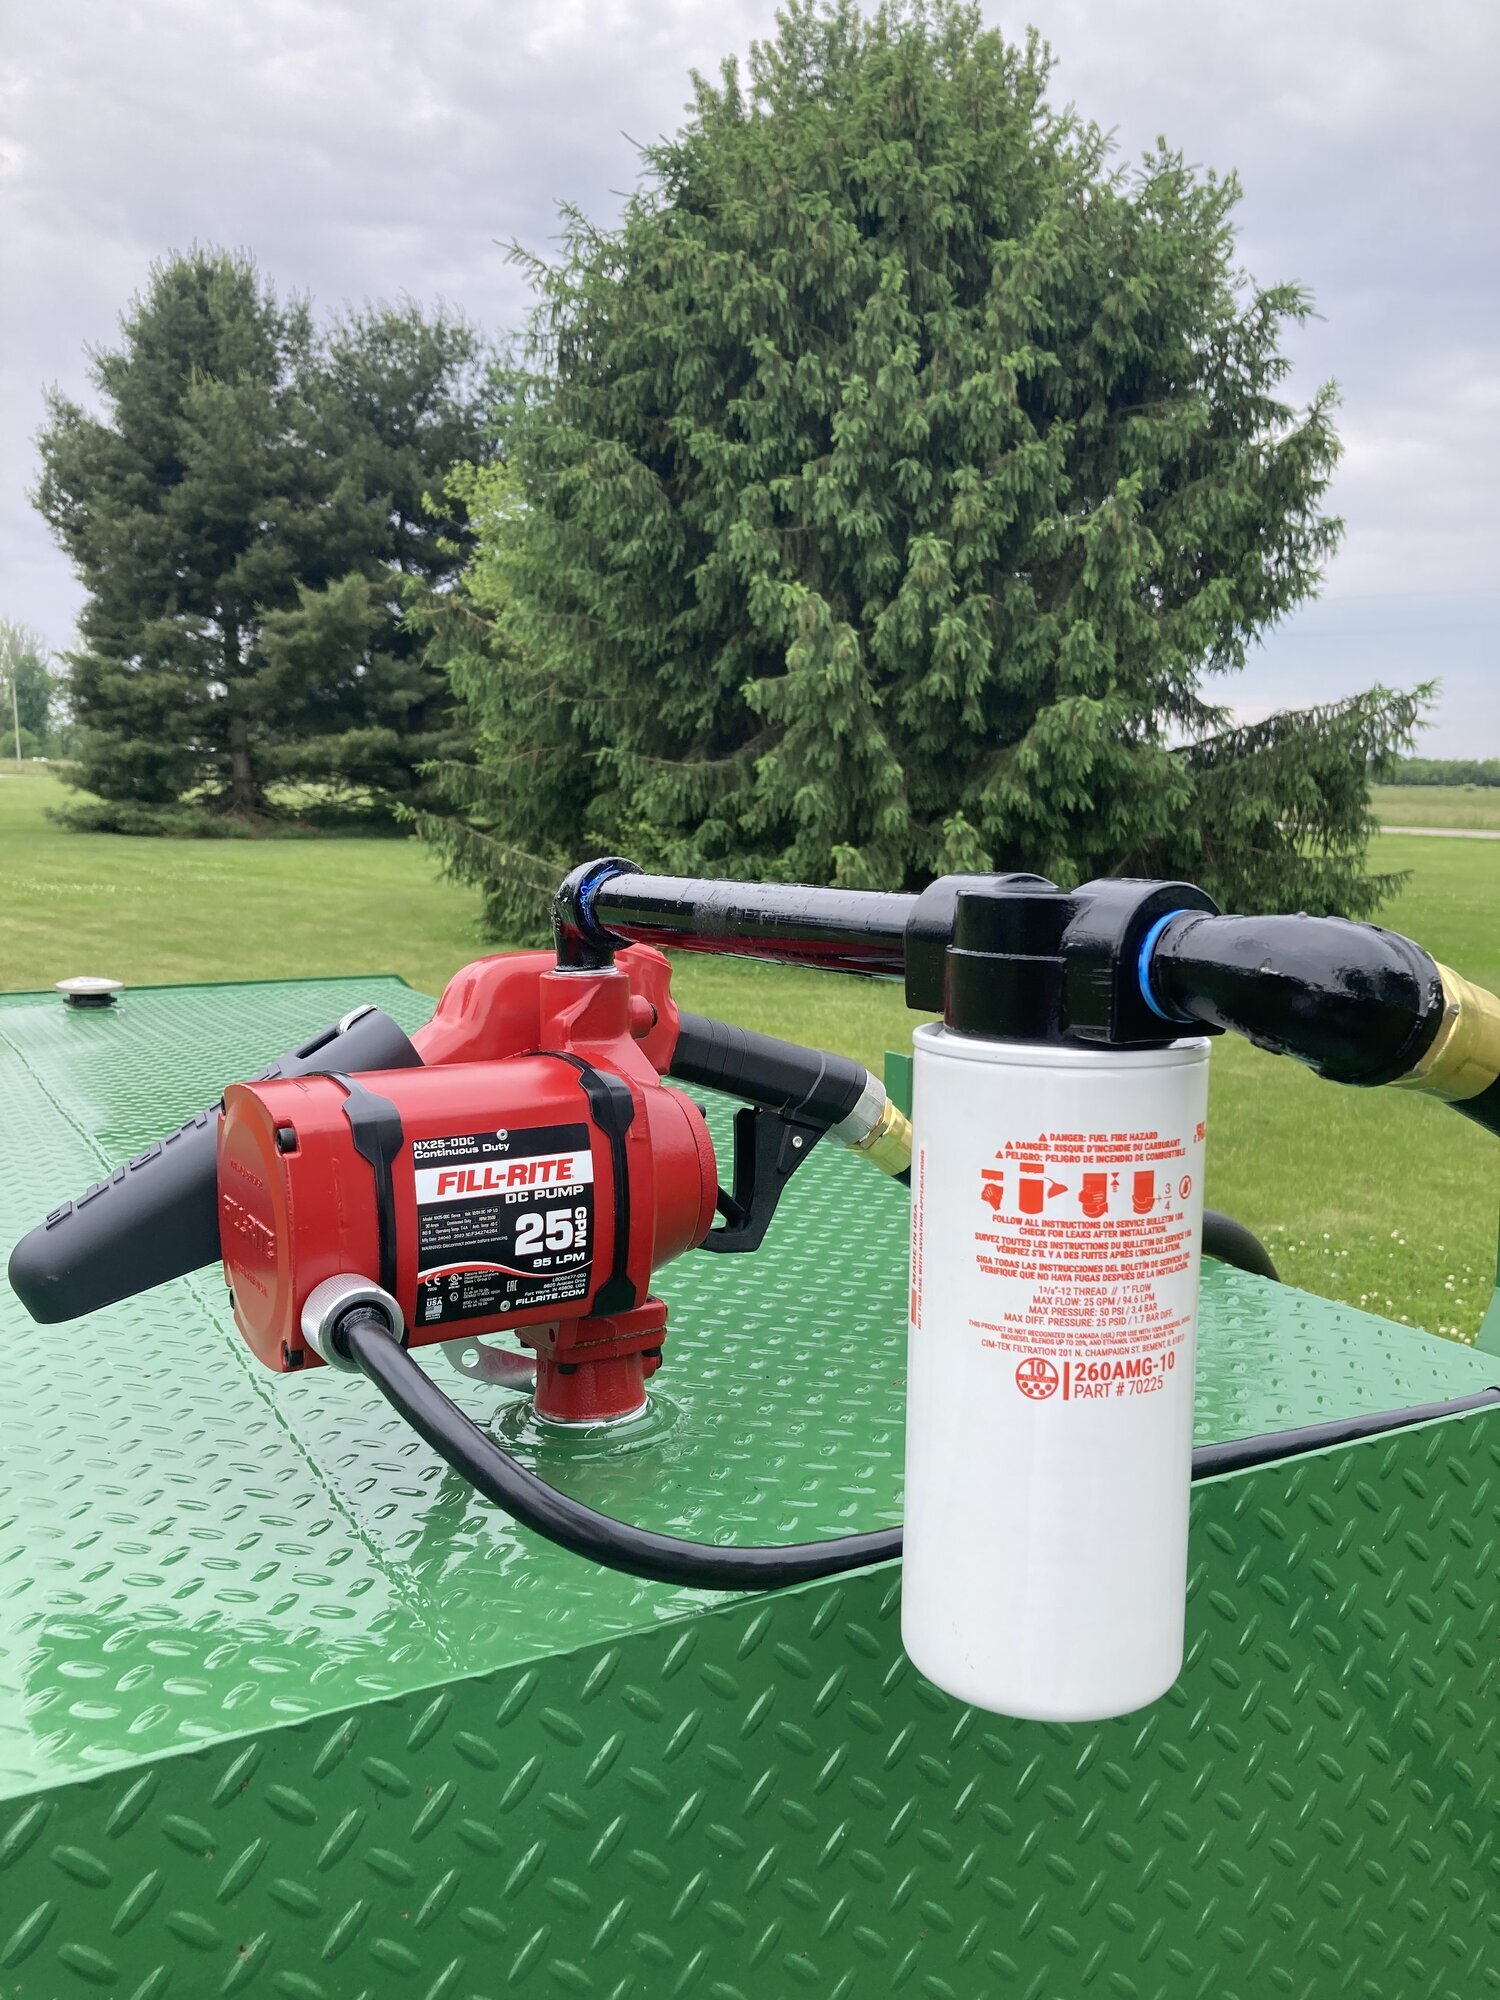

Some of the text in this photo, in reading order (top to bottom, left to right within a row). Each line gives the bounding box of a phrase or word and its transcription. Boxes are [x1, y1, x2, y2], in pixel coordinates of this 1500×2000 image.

[1049, 1132, 1158, 1142] DANGER: FUEL FIRE HAZARD
[414, 1143, 510, 1159] Continuous Duty
[1016, 1138, 1181, 1153] DANGER: RISQUE D'INCENDIE DU CARBURANT
[1005, 1151, 1043, 1162] PELIGRO:
[1045, 1154, 1081, 1163] PELIGRO
[1096, 1154, 1133, 1163] INCENDIO
[1135, 1153, 1144, 1162] DE
[1146, 1148, 1186, 1160] COMBUSTIBLE
[437, 1158, 574, 1195] FILL-RITE
[505, 1185, 584, 1204] DC PUMP
[1165, 1183, 1171, 1194] 3
[1164, 1200, 1170, 1211] 4
[574, 1206, 587, 1247] GPM
[992, 1214, 1174, 1229] FOLLOW ALL INSTRUCTIONS ON SERVICE BULLETIN
[515, 1208, 574, 1256] 25
[912, 1231, 917, 1247] IN
[1019, 1225, 1167, 1238] CHECK FOR LEAKS AFTER INSTALLATION.
[975, 1232, 1184, 1250] SUIVEZ TOUTES LES INSTRUCTIONS DU BULLETIN DE SERVICE
[533, 1252, 586, 1268] 95 LPM
[1032, 1249, 1046, 1257] S'IL
[1048, 1250, 1054, 1258] Y
[1055, 1251, 1062, 1259] A
[1063, 1251, 1079, 1259] DES
[1110, 1249, 1133, 1259] APRÈS
[976, 1254, 992, 1264] SIGA
[994, 1258, 1020, 1268] TODAS
[1021, 1262, 1037, 1270] LAS
[1039, 1263, 1103, 1273] INSTRUCCIONES
[1105, 1264, 1118, 1272] DEL
[1151, 1260, 1158, 1268] DE
[1160, 1255, 1182, 1266] SERVICIO
[980, 1264, 1017, 1277] VERIFIQUE
[1019, 1271, 1035, 1279] QUE
[1037, 1272, 1049, 1280] NO
[1051, 1274, 1072, 1282] HAYA
[1074, 1274, 1100, 1282] FUGAS
[1137, 1271, 1145, 1279] DE
[1146, 1270, 1155, 1278] LA
[515, 1289, 585, 1306] FILLRITE.COM
[1073, 1287, 1107, 1296] THREAD
[1132, 1283, 1152, 1293] FLOW
[1033, 1296, 1053, 1305] MAX
[1055, 1297, 1082, 1306] FLOW:
[1084, 1298, 1094, 1306] 25
[1096, 1297, 1115, 1306] GPM
[1123, 1295, 1139, 1304] 94.6
[1140, 1293, 1155, 1303] LPM
[1004, 1312, 1023, 1323] MAX
[1025, 1315, 1045, 1325] DIFF.
[1048, 1317, 1094, 1327] PRESSURE:
[1096, 1318, 1106, 1326] 25
[1109, 1317, 1127, 1326] PSID
[1134, 1315, 1144, 1324] 1.7
[1146, 1313, 1159, 1322] BAR
[1160, 1308, 1173, 1320] DIFF.
[1029, 1305, 1049, 1315] MAX
[1051, 1307, 1097, 1316] PRESSURE:
[1100, 1308, 1109, 1316] 50
[1112, 1307, 1124, 1315] PSI
[1131, 1305, 1142, 1314] 3.4
[1144, 1303, 1158, 1312] BAR
[981, 1322, 1006, 1332] PRODUCT
[1028, 1330, 1065, 1338] RECOGNIZED
[1139, 1328, 1151, 1336] WITH
[981, 1339, 1011, 1351] CIM-TEK
[1013, 1344, 1056, 1356] FILTRATION
[1058, 1348, 1072, 1357] 201
[1075, 1349, 1082, 1357] N.
[1085, 1347, 1130, 1357] CHAMPAIGN
[1031, 1336, 1054, 1345] BLENDS
[1130, 1335, 1152, 1343] CONTENT
[1028, 1360, 1046, 1376] 10
[1074, 1352, 1175, 1381] 260AMG-10
[1074, 1375, 1164, 1399] PART # 70225
